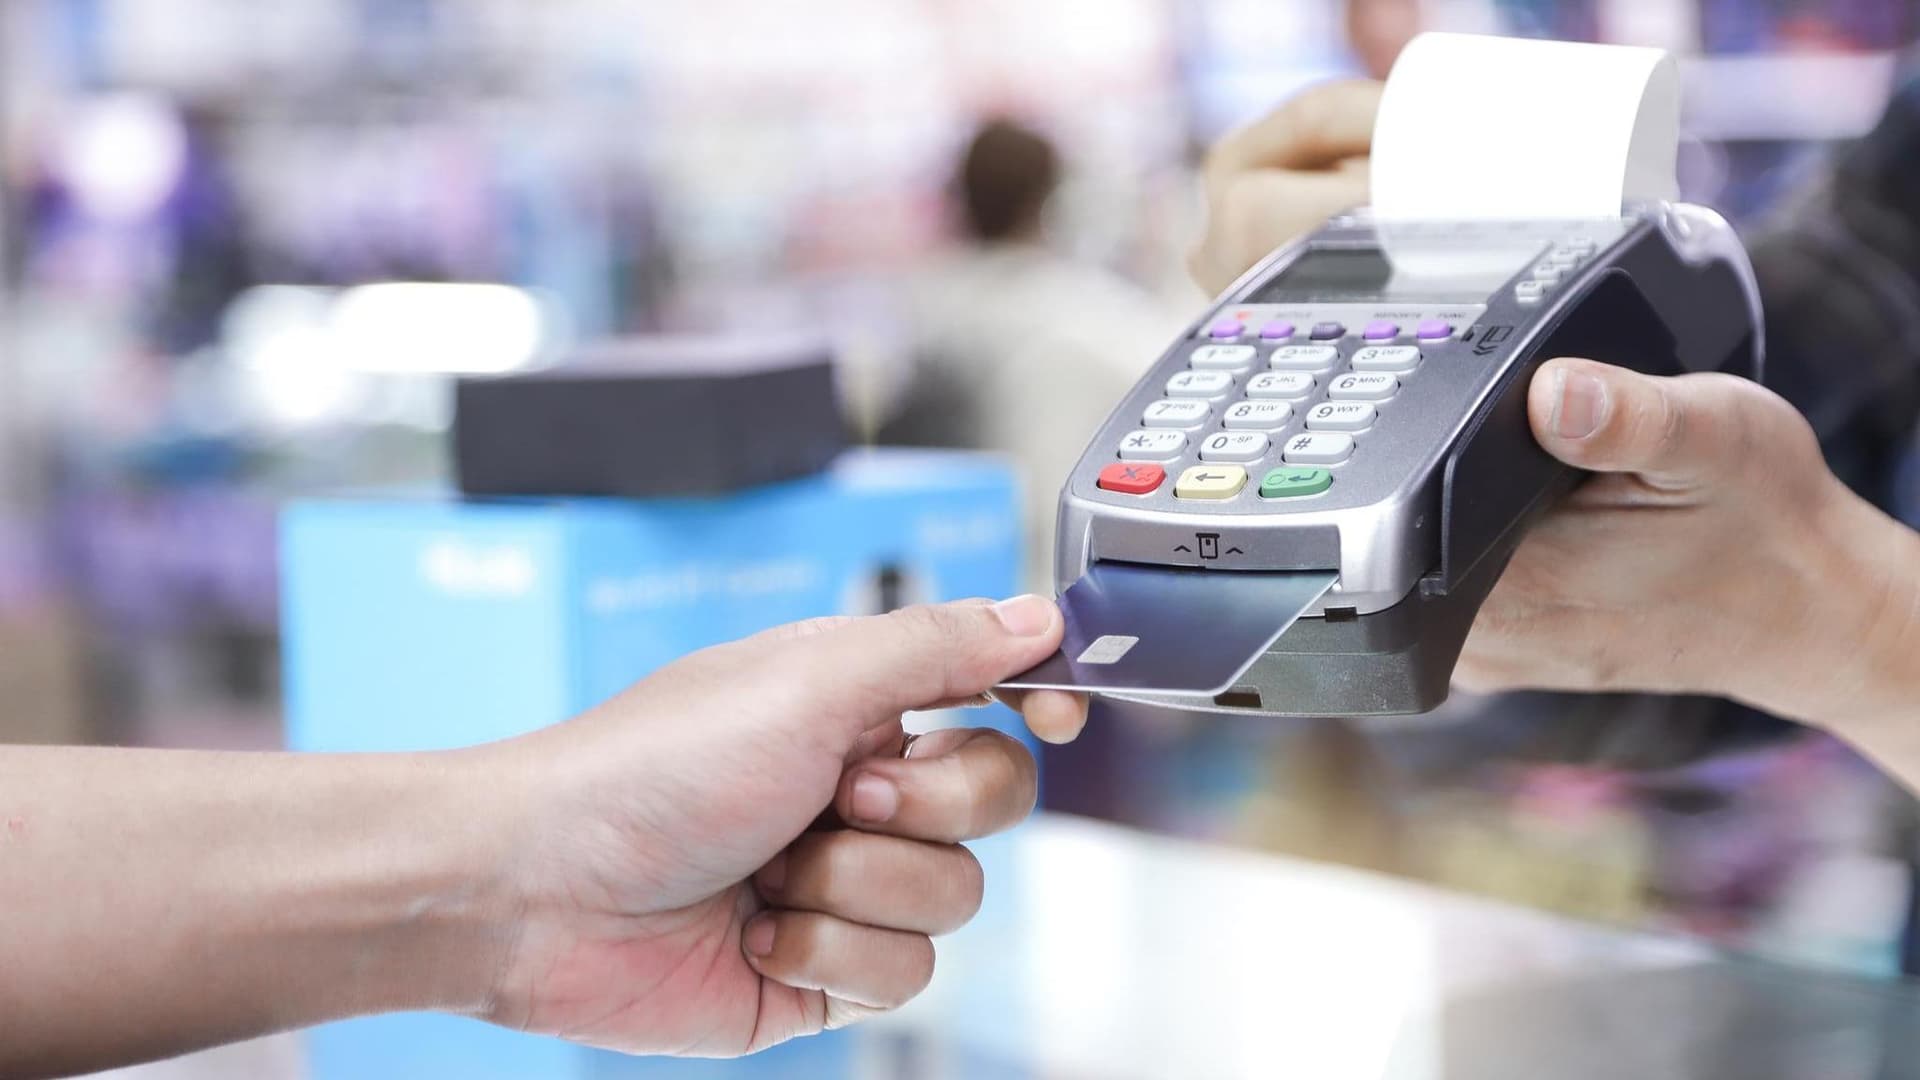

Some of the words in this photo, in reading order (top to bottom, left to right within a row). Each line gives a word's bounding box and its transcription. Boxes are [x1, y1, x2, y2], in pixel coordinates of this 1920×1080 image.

[1280, 348, 1298, 359] 2
[1362, 349, 1378, 360] 3
[1177, 376, 1193, 386] 4
[1257, 376, 1275, 388] 5
[1340, 377, 1357, 389] 6
[1359, 376, 1387, 384] MNO
[1155, 403, 1172, 415] 7
[1234, 404, 1251, 417] 8
[1256, 404, 1278, 412] TUV
[1316, 406, 1334, 418] 9
[1337, 405, 1363, 413] WXY
[1211, 436, 1228, 449] 0
[1291, 436, 1312, 450] #
